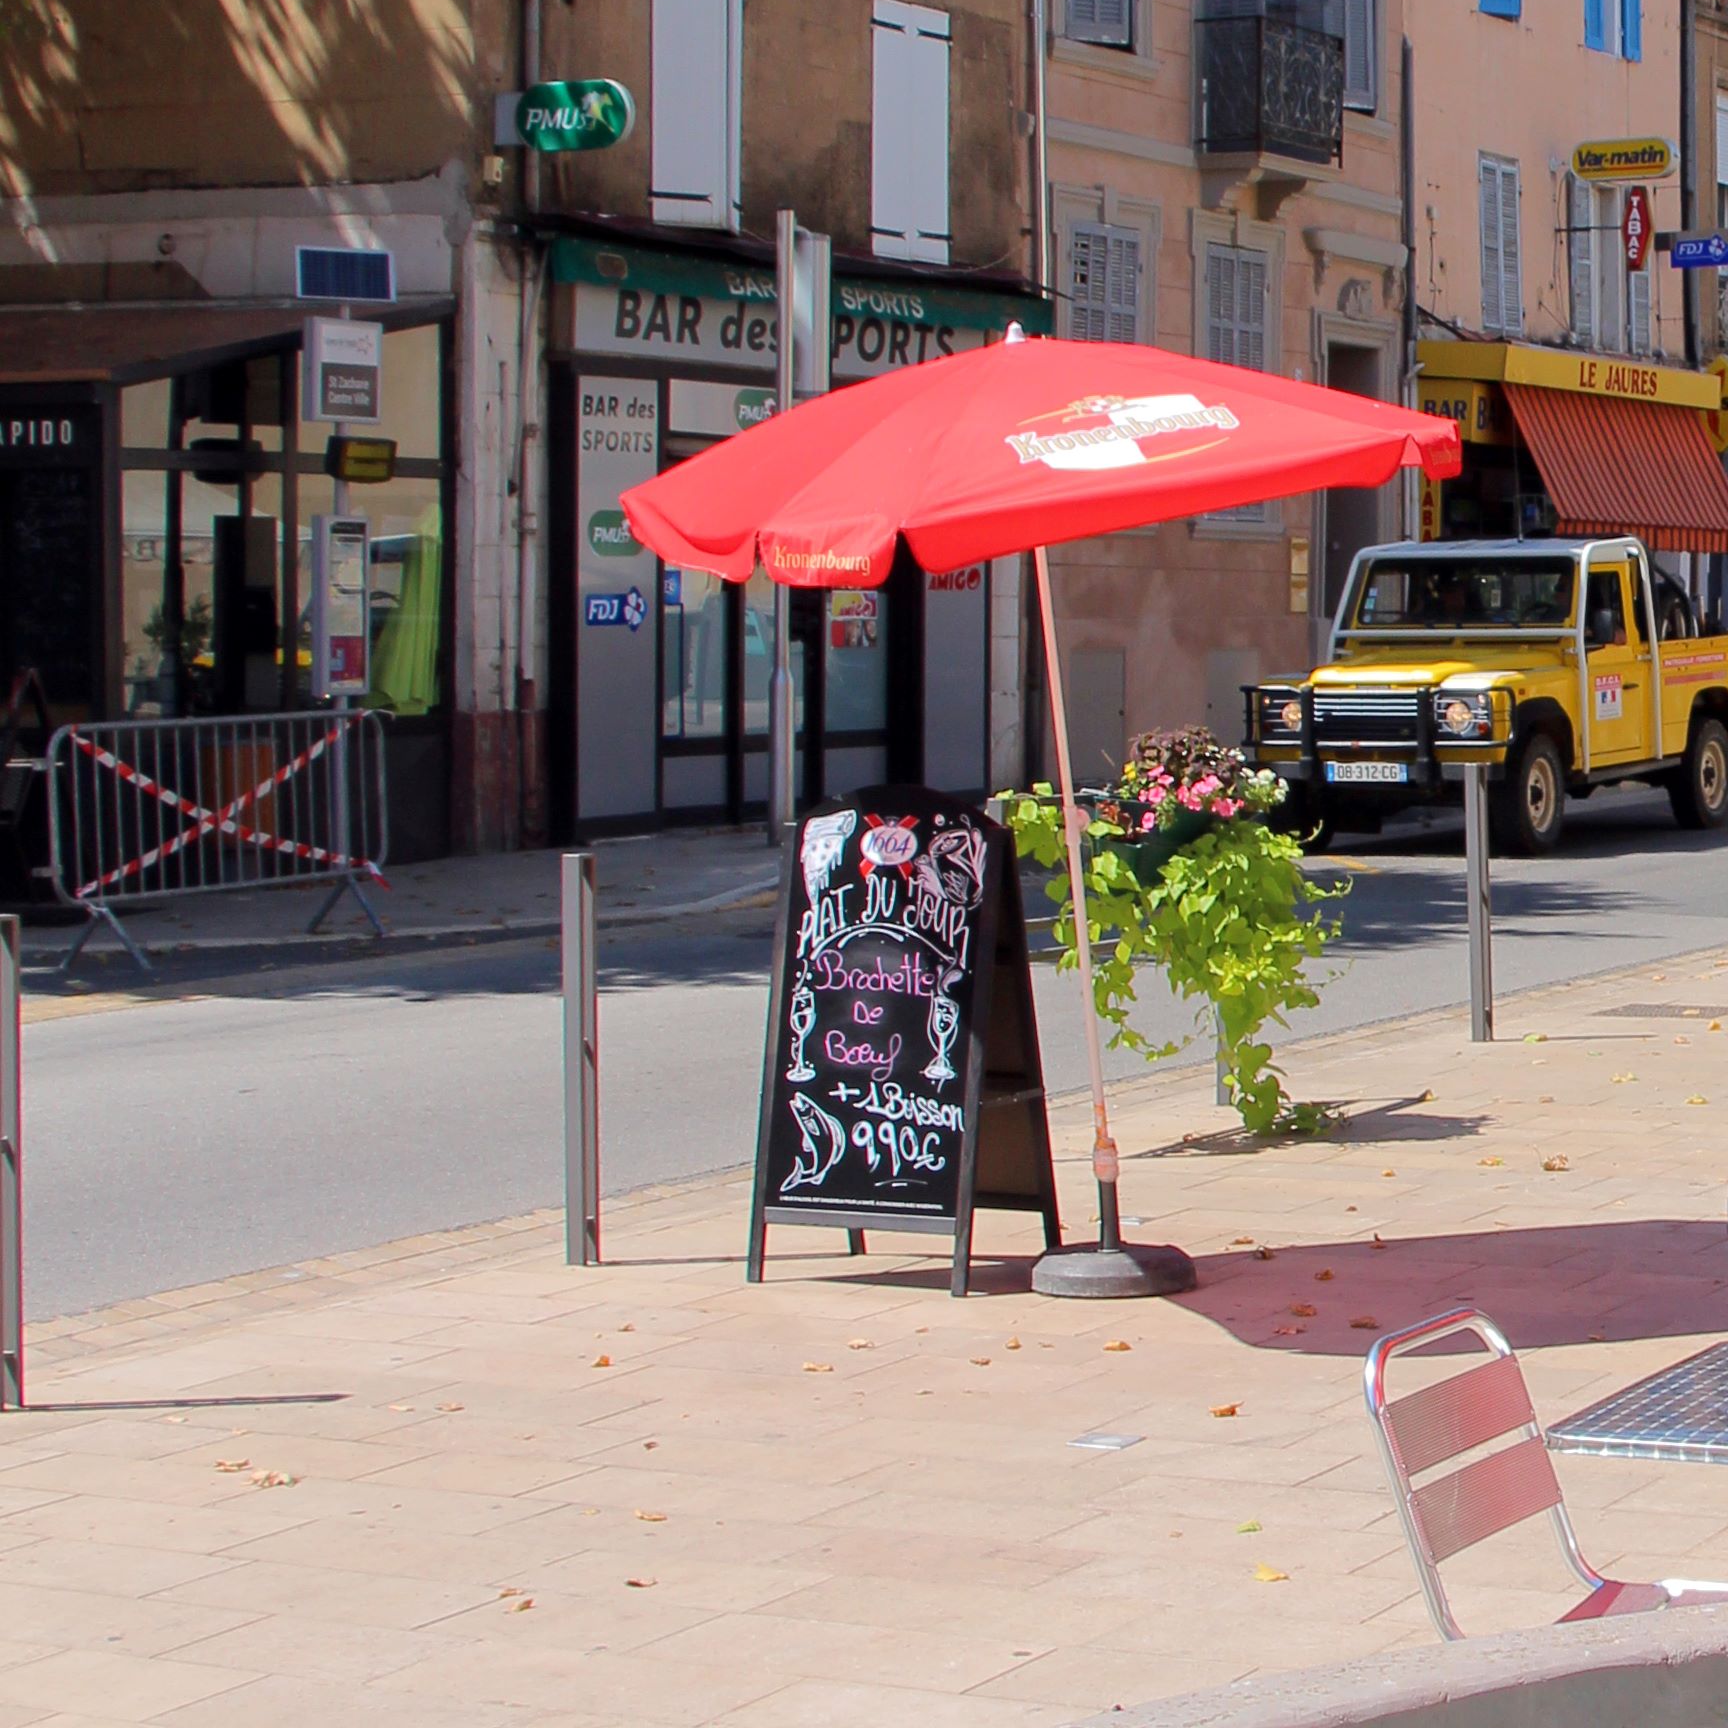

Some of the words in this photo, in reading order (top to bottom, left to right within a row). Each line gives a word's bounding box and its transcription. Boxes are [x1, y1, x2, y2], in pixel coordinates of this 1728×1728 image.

[525, 107, 579, 131] PMU
[1576, 145, 1665, 168] Var-matin
[1627, 195, 1642, 260] TABAC
[1678, 242, 1704, 255] FDJ
[727, 272, 778, 300] BAR
[841, 285, 924, 319] SPORTS
[614, 289, 703, 346] BAR
[832, 314, 956, 365] PORTS
[1579, 360, 1597, 389] LE
[1604, 364, 1658, 397] JAURES
[582, 394, 619, 418] BAR
[626, 396, 655, 419] des
[738, 403, 764, 421] PMU
[1423, 399, 1467, 421] BAR
[0, 419, 73, 446] PIDO
[581, 428, 653, 454] SPORTS
[1006, 405, 1239, 463] Kronenbourg
[592, 526, 620, 543] PMU
[774, 545, 871, 576] Kronenbourg
[928, 568, 981, 592] AMIGO
[588, 598, 619, 621] FDJ
[866, 832, 911, 855] 1664
[796, 882, 855, 960] PLAT
[860, 873, 897, 923] DU
[902, 876, 971, 970] JOUR
